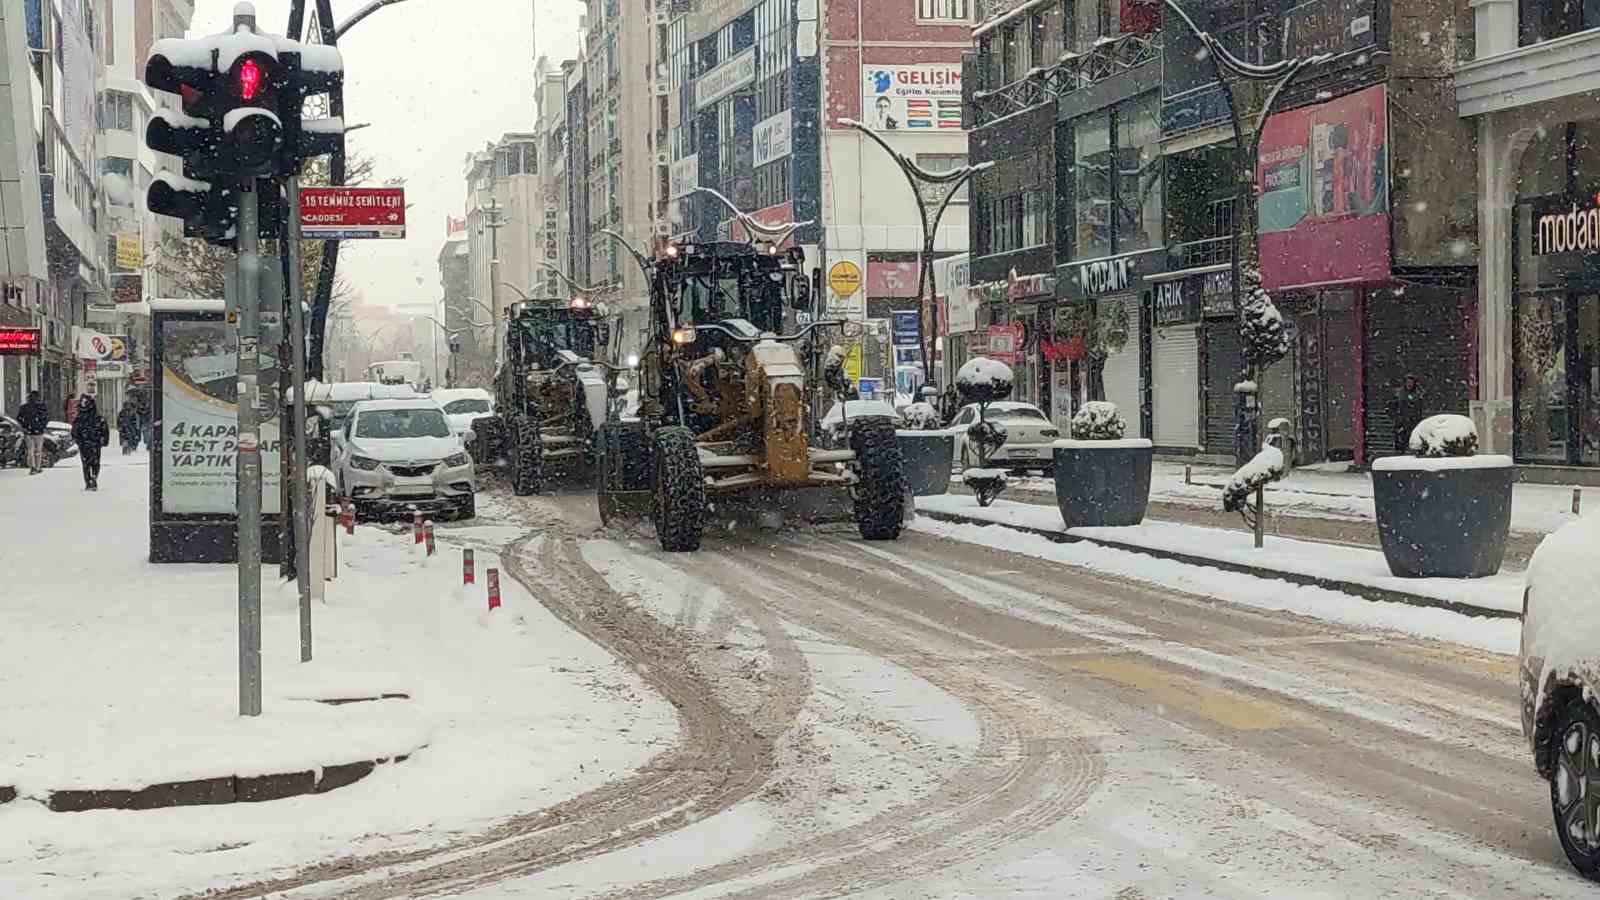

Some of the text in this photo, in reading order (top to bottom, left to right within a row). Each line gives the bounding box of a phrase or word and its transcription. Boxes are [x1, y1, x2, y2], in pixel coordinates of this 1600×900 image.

[1540, 202, 1600, 254] modan
[1156, 281, 1184, 309] ARIK
[171, 422, 238, 437] 4 KAPA
[172, 455, 233, 467] YAPTIK
